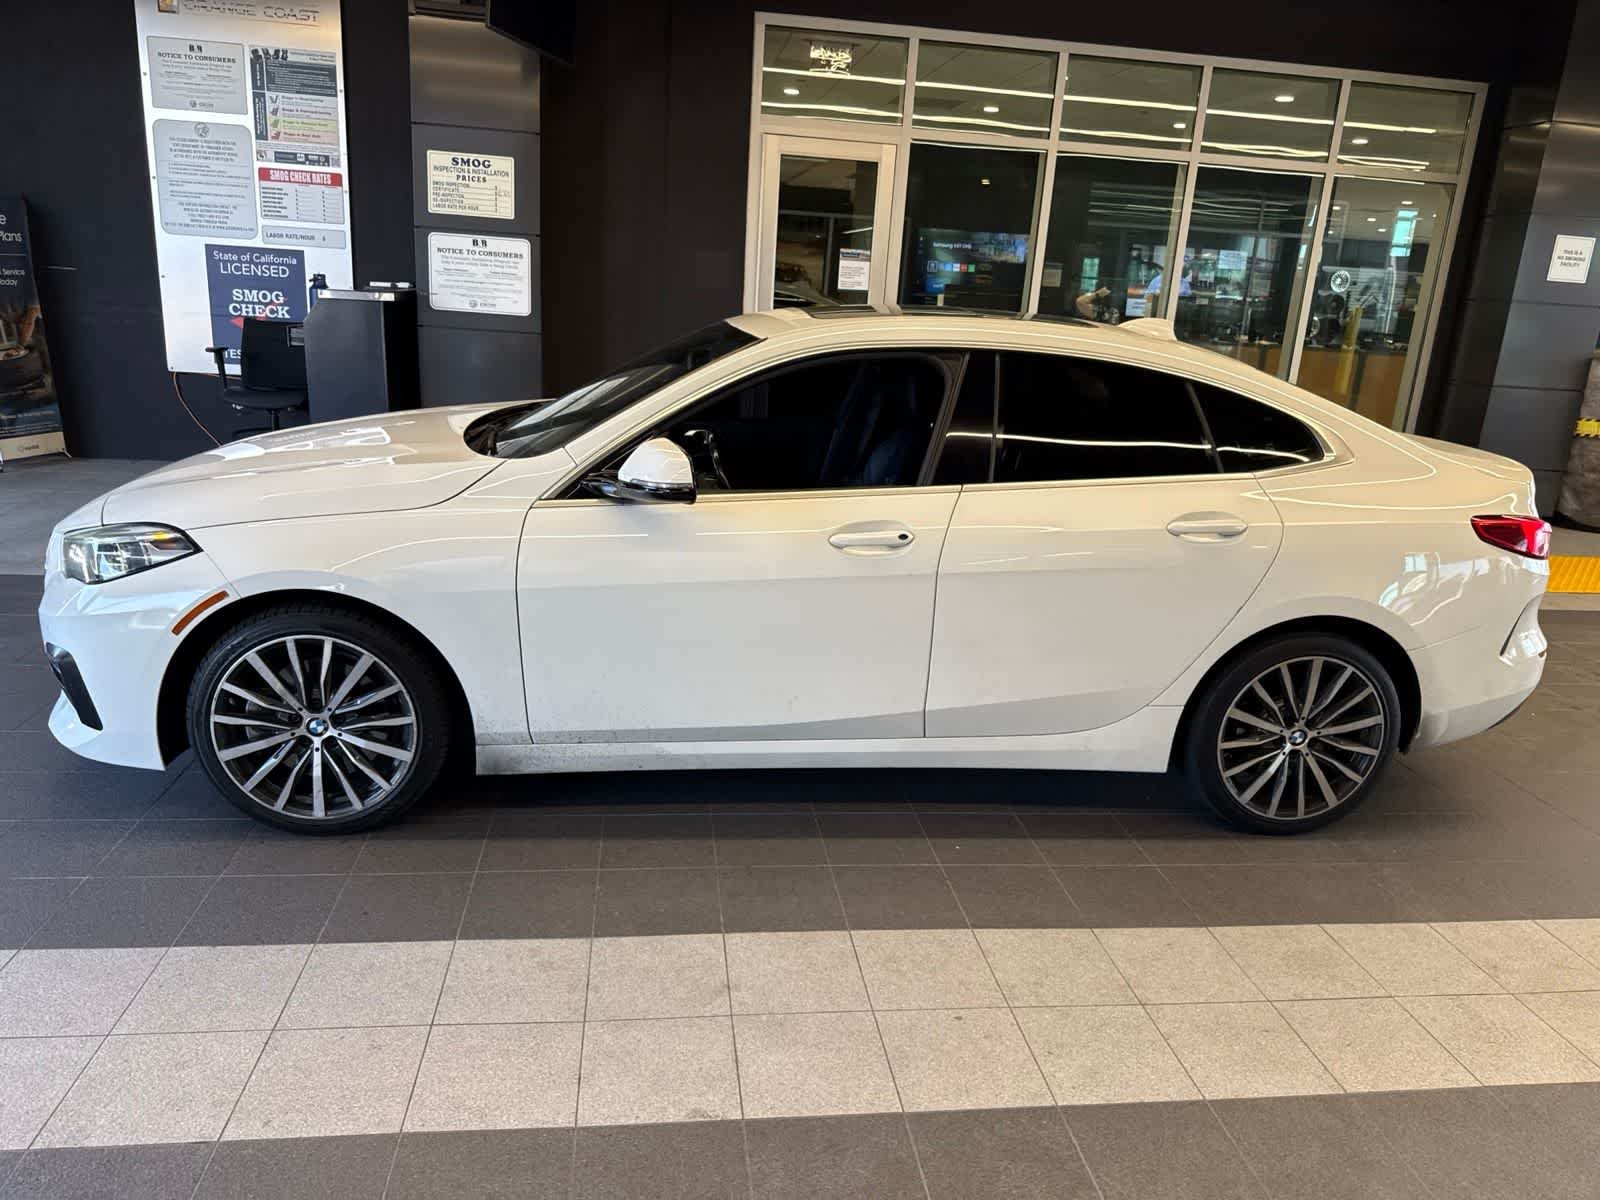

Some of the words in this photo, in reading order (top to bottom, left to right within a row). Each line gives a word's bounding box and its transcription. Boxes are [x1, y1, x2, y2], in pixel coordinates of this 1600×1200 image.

[264, 6, 319, 22] COAST
[157, 52, 181, 60] NOTICE
[195, 55, 237, 64] CONSUMERS
[452, 157, 491, 169] SMOG
[270, 169, 289, 181] SMOG
[290, 172, 311, 183] CHECK
[312, 173, 332, 185] RATES
[433, 165, 466, 174] INSPECTION
[472, 168, 509, 177] INSTALLATION
[456, 174, 487, 183] PRICES
[213, 250, 238, 261] State
[240, 252, 251, 261] of
[252, 253, 297, 265] California
[437, 247, 464, 255] NOTICE
[478, 250, 524, 260] CONSUMERS
[220, 263, 289, 277] LICENSED
[232, 288, 285, 304] SMOG
[229, 304, 290, 318] CHECK
